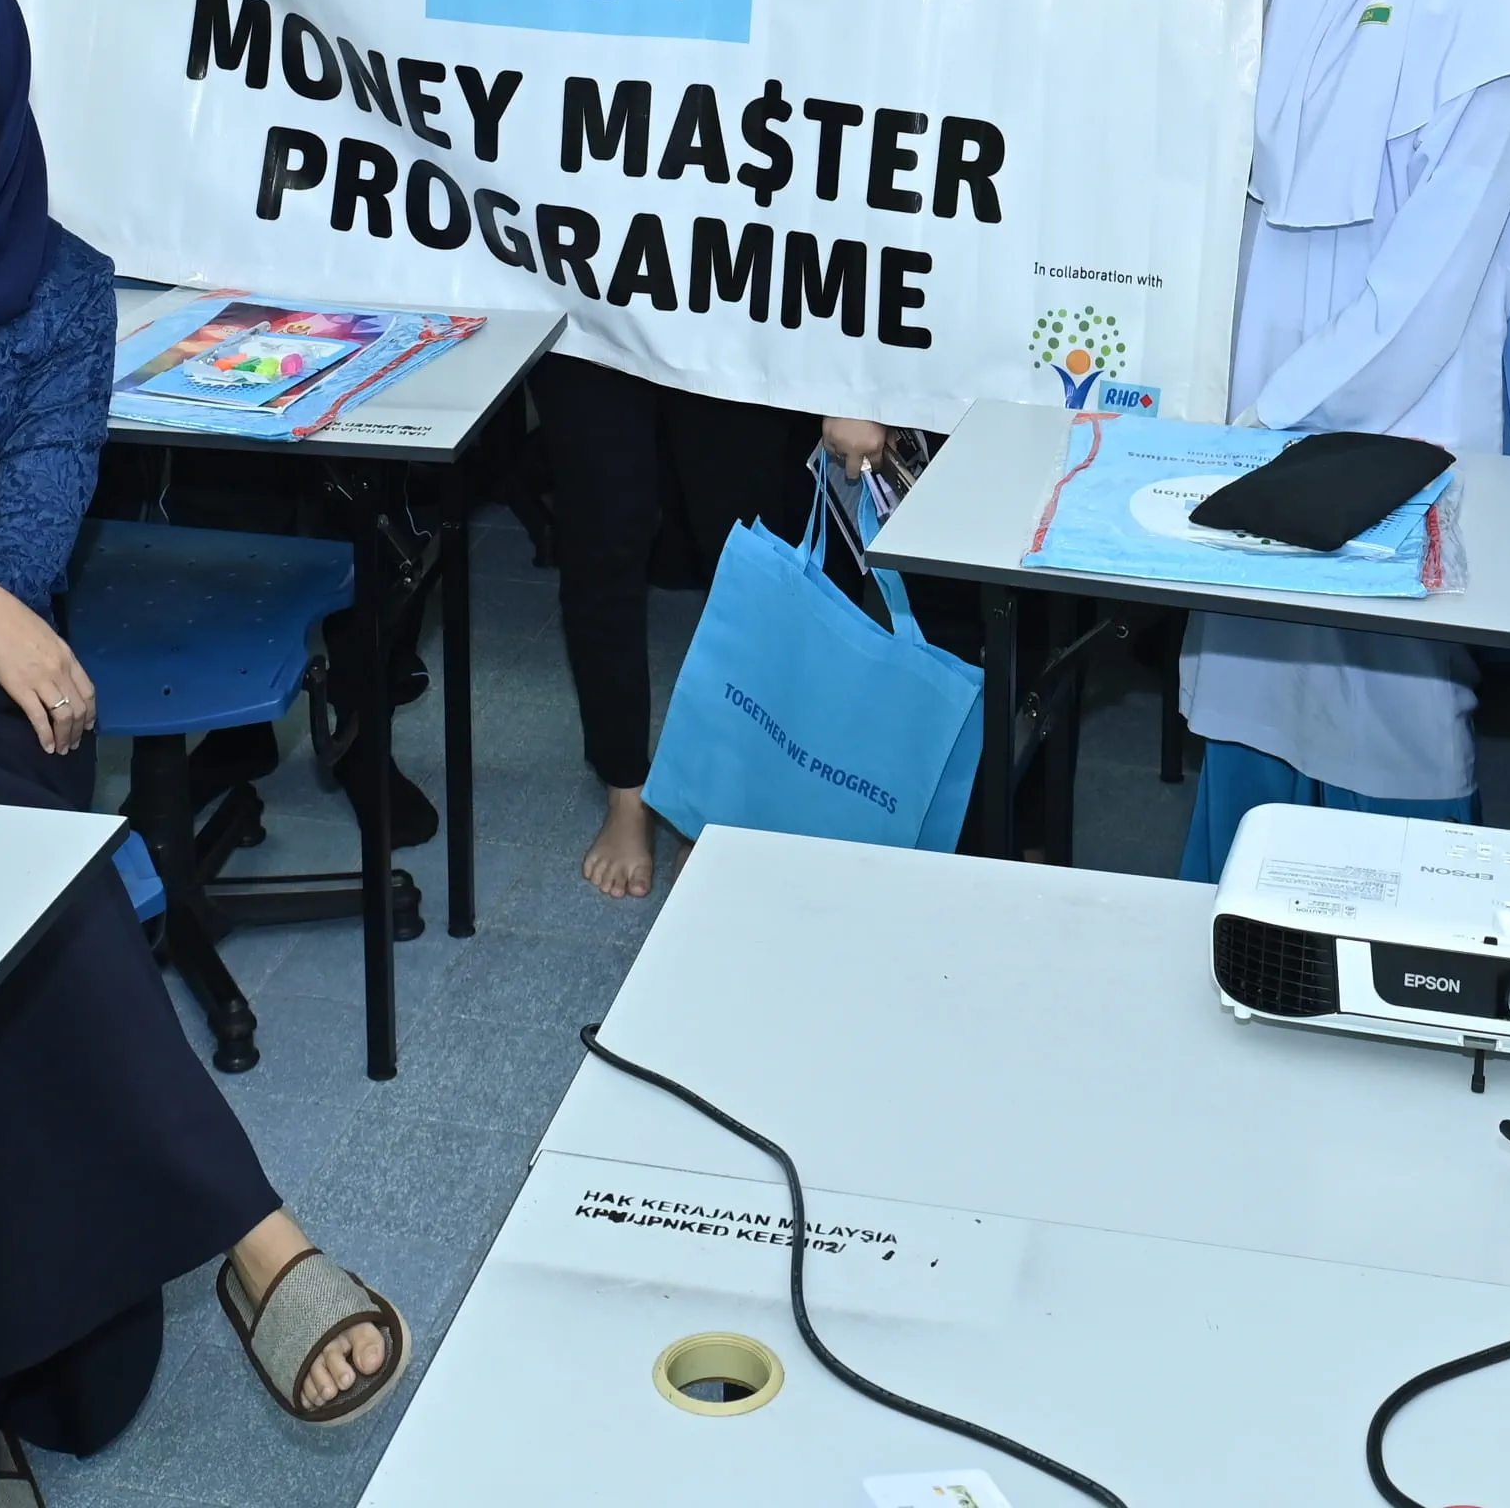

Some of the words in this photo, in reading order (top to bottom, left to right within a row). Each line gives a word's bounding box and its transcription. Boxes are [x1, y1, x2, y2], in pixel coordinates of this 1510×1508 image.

[560, 76, 1006, 224] MA$TER
[255, 125, 933, 350] PROGRAMME
[1034, 262, 1046, 276] In
[1049, 266, 1133, 284] collaboration
[1137, 274, 1163, 289] with
[1105, 388, 1140, 407] RHB
[725, 682, 787, 749] TOGETHER
[787, 740, 809, 768] WE
[809, 757, 898, 814] PROGRESS
[1420, 866, 1494, 880] EPSON
[1404, 973, 1461, 993] EPSON
[583, 1190, 633, 1207] HAK
[640, 1198, 771, 1227] KERAJAAN
